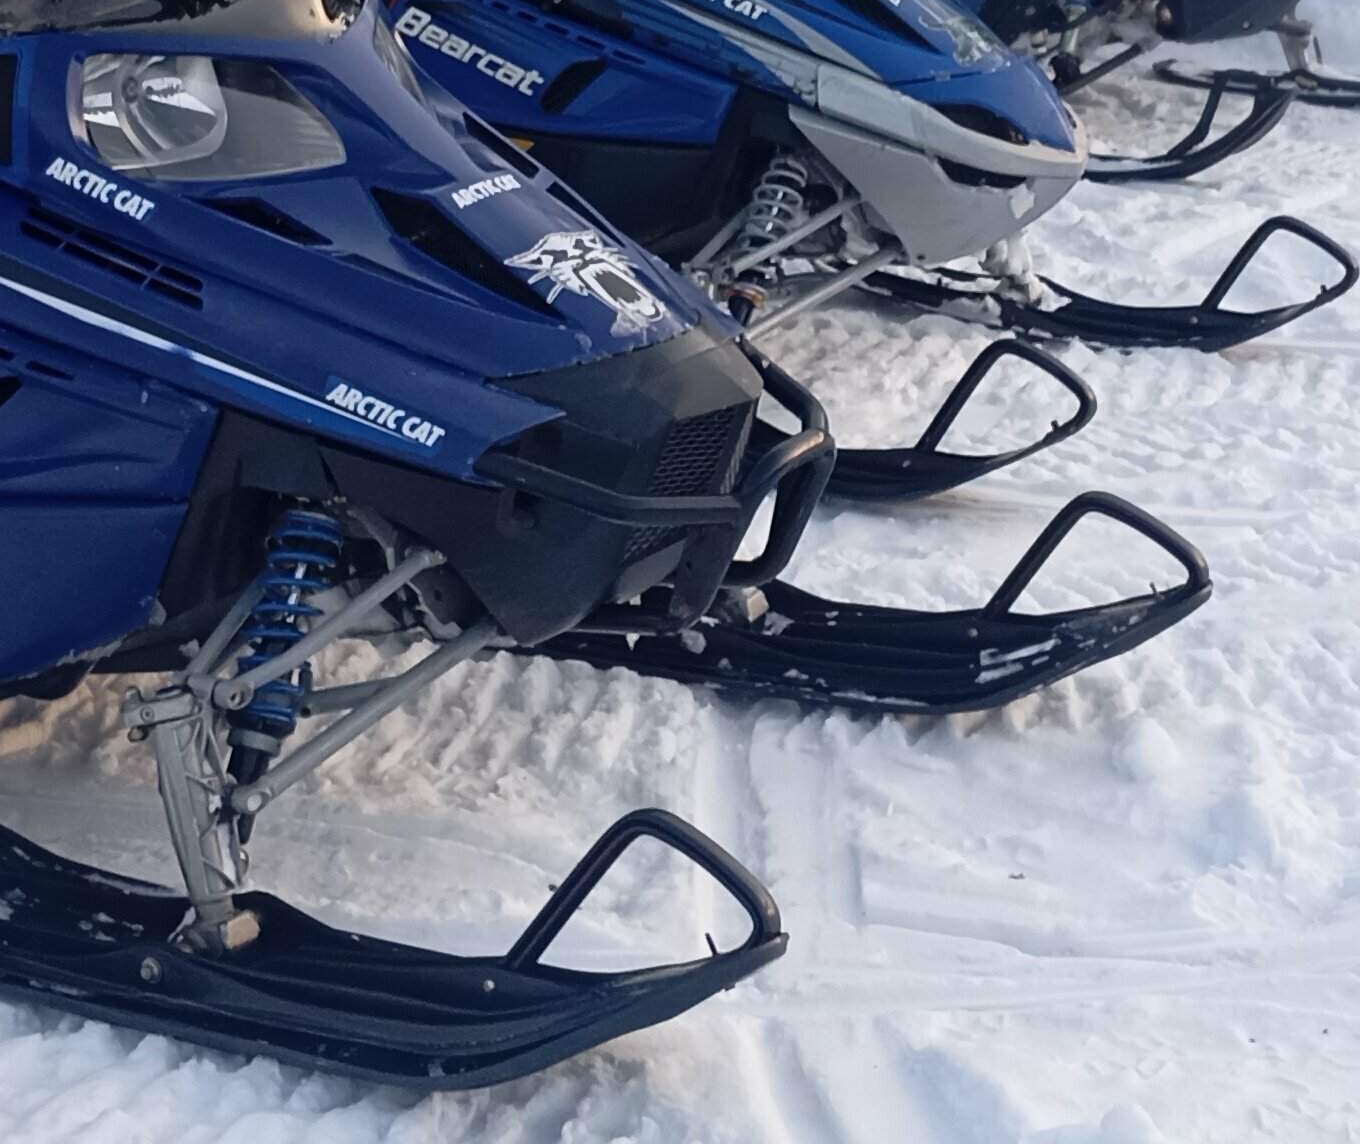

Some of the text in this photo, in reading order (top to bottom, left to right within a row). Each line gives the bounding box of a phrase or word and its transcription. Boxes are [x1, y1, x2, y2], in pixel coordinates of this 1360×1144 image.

[394, 6, 544, 96] Bearcat
[45, 157, 155, 221] ARCTIC CAT
[451, 179, 501, 209] ARCTIC
[326, 383, 446, 447] ARCTIC CAT
